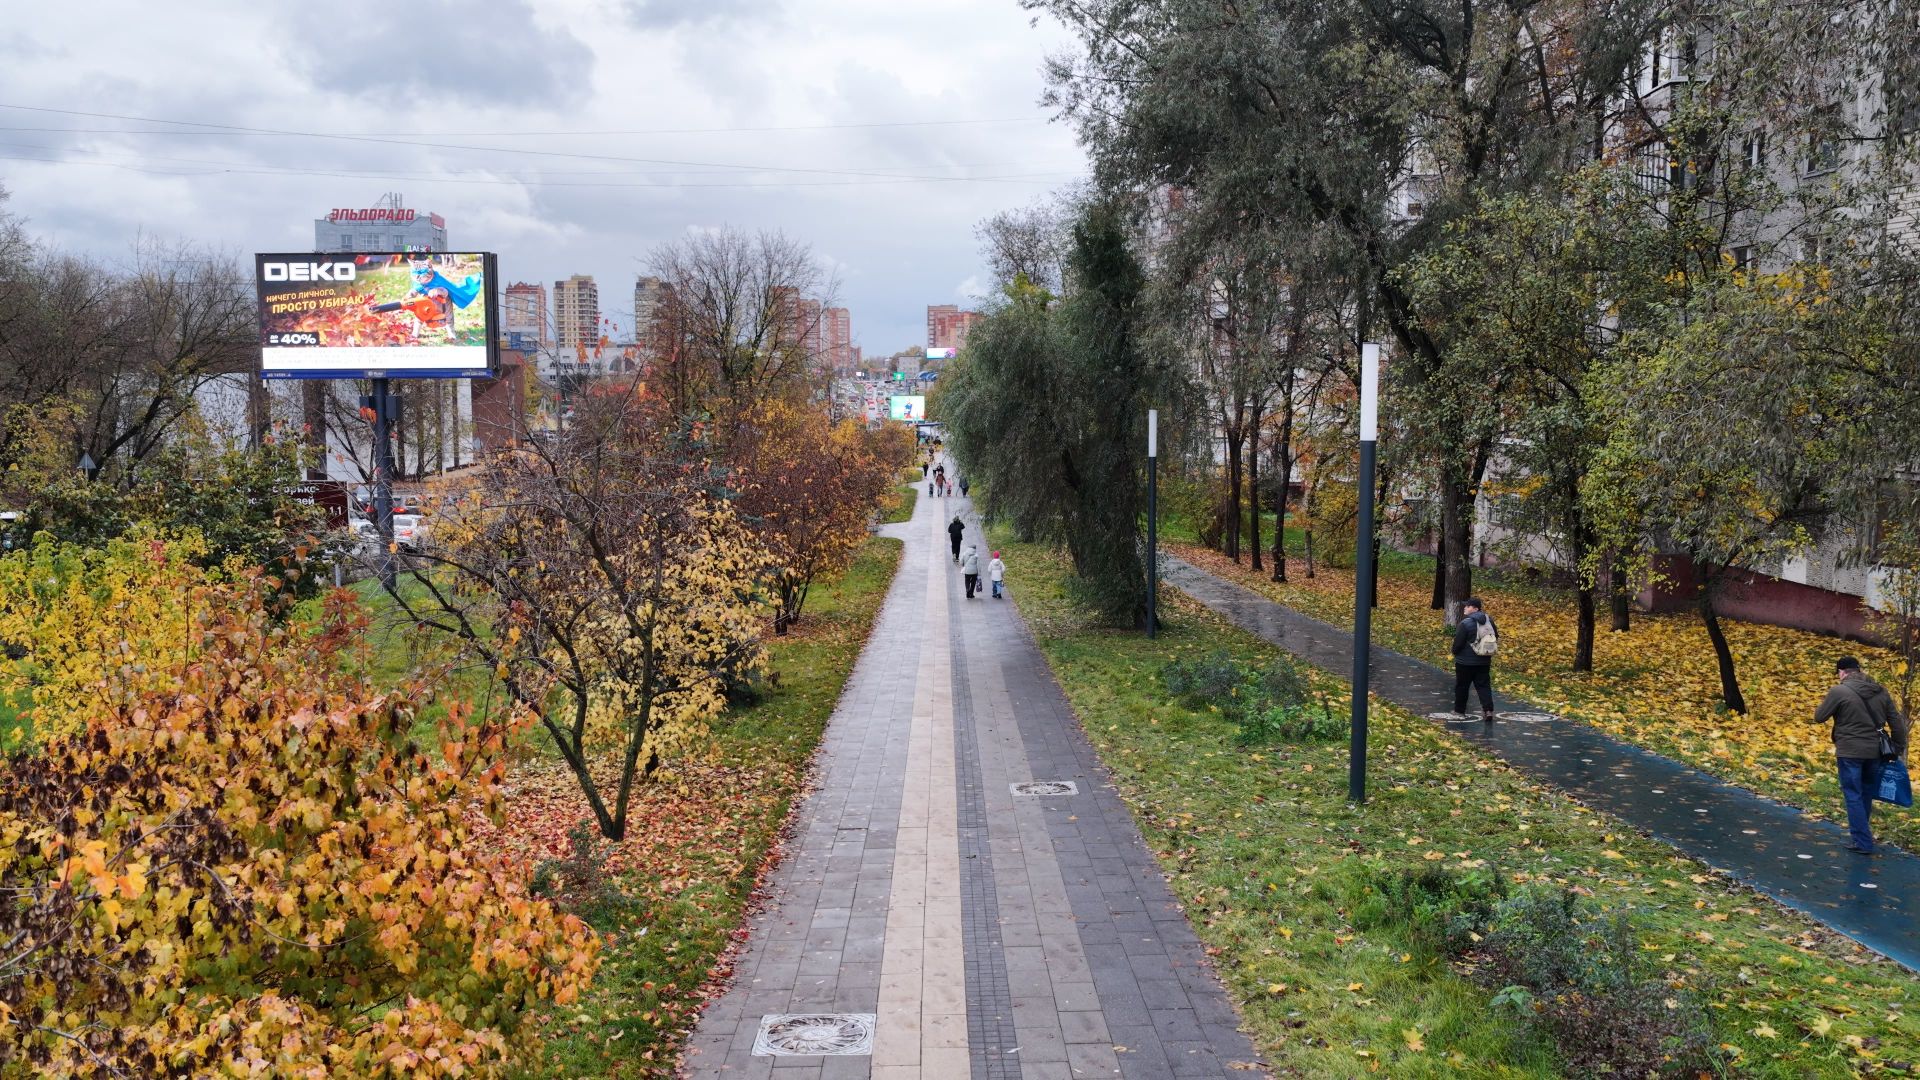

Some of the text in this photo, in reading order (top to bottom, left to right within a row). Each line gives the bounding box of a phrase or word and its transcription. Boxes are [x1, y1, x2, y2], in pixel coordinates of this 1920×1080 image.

[331, 208, 415, 221] ЭЛЬДОРАДО
[264, 262, 356, 282] DEKO
[266, 288, 336, 303] НИЧЕГО ЛИЧНОГО,
[272, 295, 365, 314] ПРОСТО УБИРАЮ
